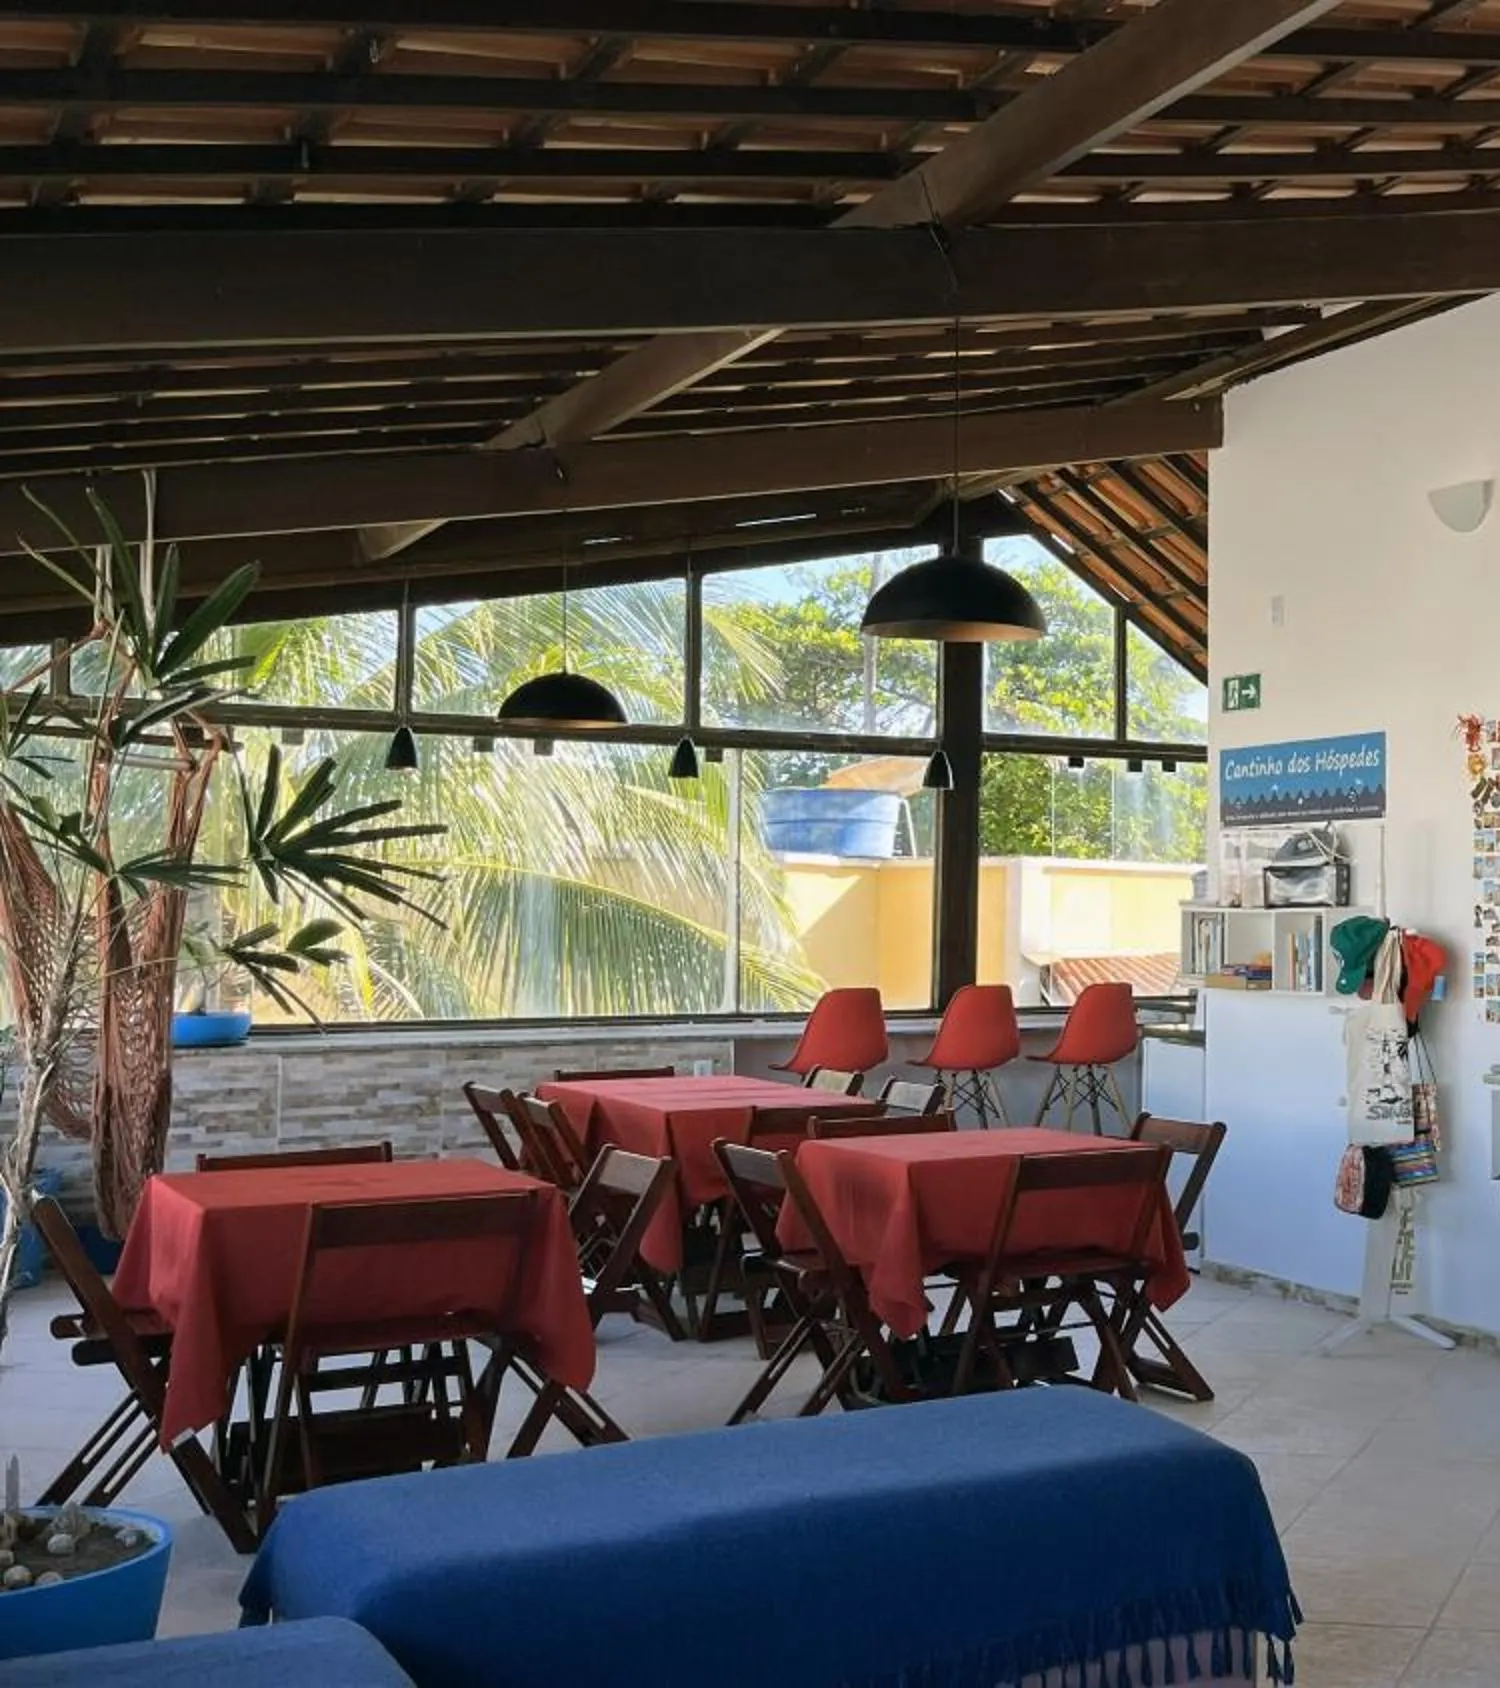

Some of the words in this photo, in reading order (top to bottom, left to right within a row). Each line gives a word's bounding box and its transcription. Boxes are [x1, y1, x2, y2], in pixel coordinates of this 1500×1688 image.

[1225, 755, 1283, 781] Cantinho
[1287, 751, 1311, 774] dos
[1315, 744, 1380, 777] Hóspedes
